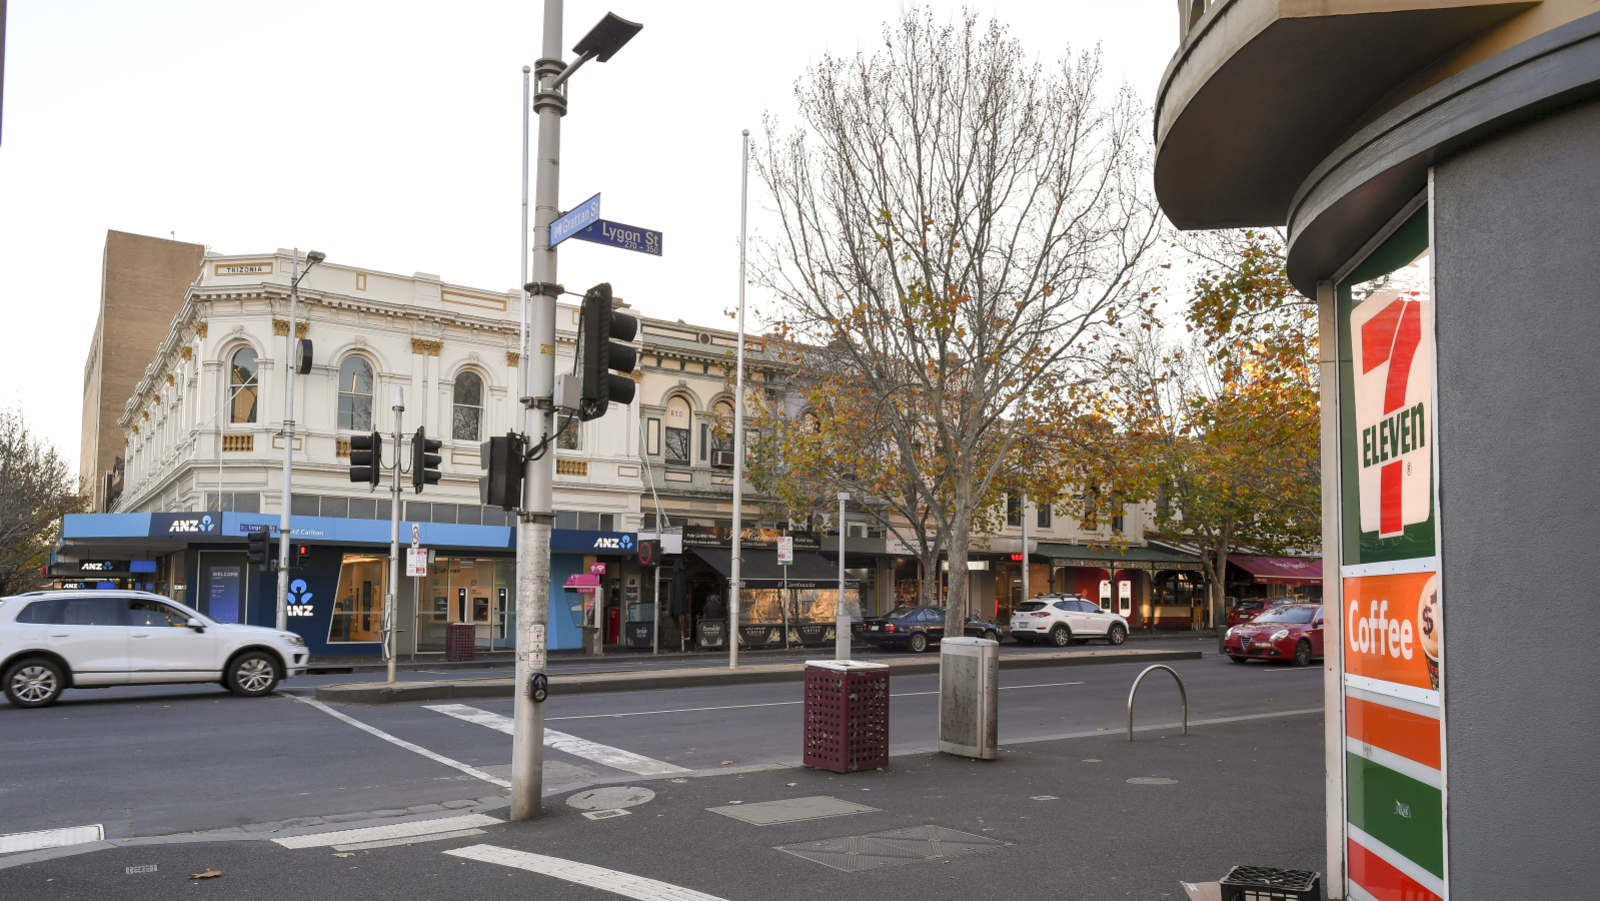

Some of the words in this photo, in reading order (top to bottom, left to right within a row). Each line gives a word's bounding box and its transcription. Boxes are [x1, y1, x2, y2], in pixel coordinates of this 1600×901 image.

[602, 221, 641, 243] Lygon
[645, 231, 659, 246] St
[624, 240, 637, 249] 270
[645, 244, 659, 254] 350
[169, 519, 199, 532] ANZ
[593, 537, 620, 549] ANZ
[81, 562, 103, 571] ANZ
[1348, 599, 1414, 661] Coffee
